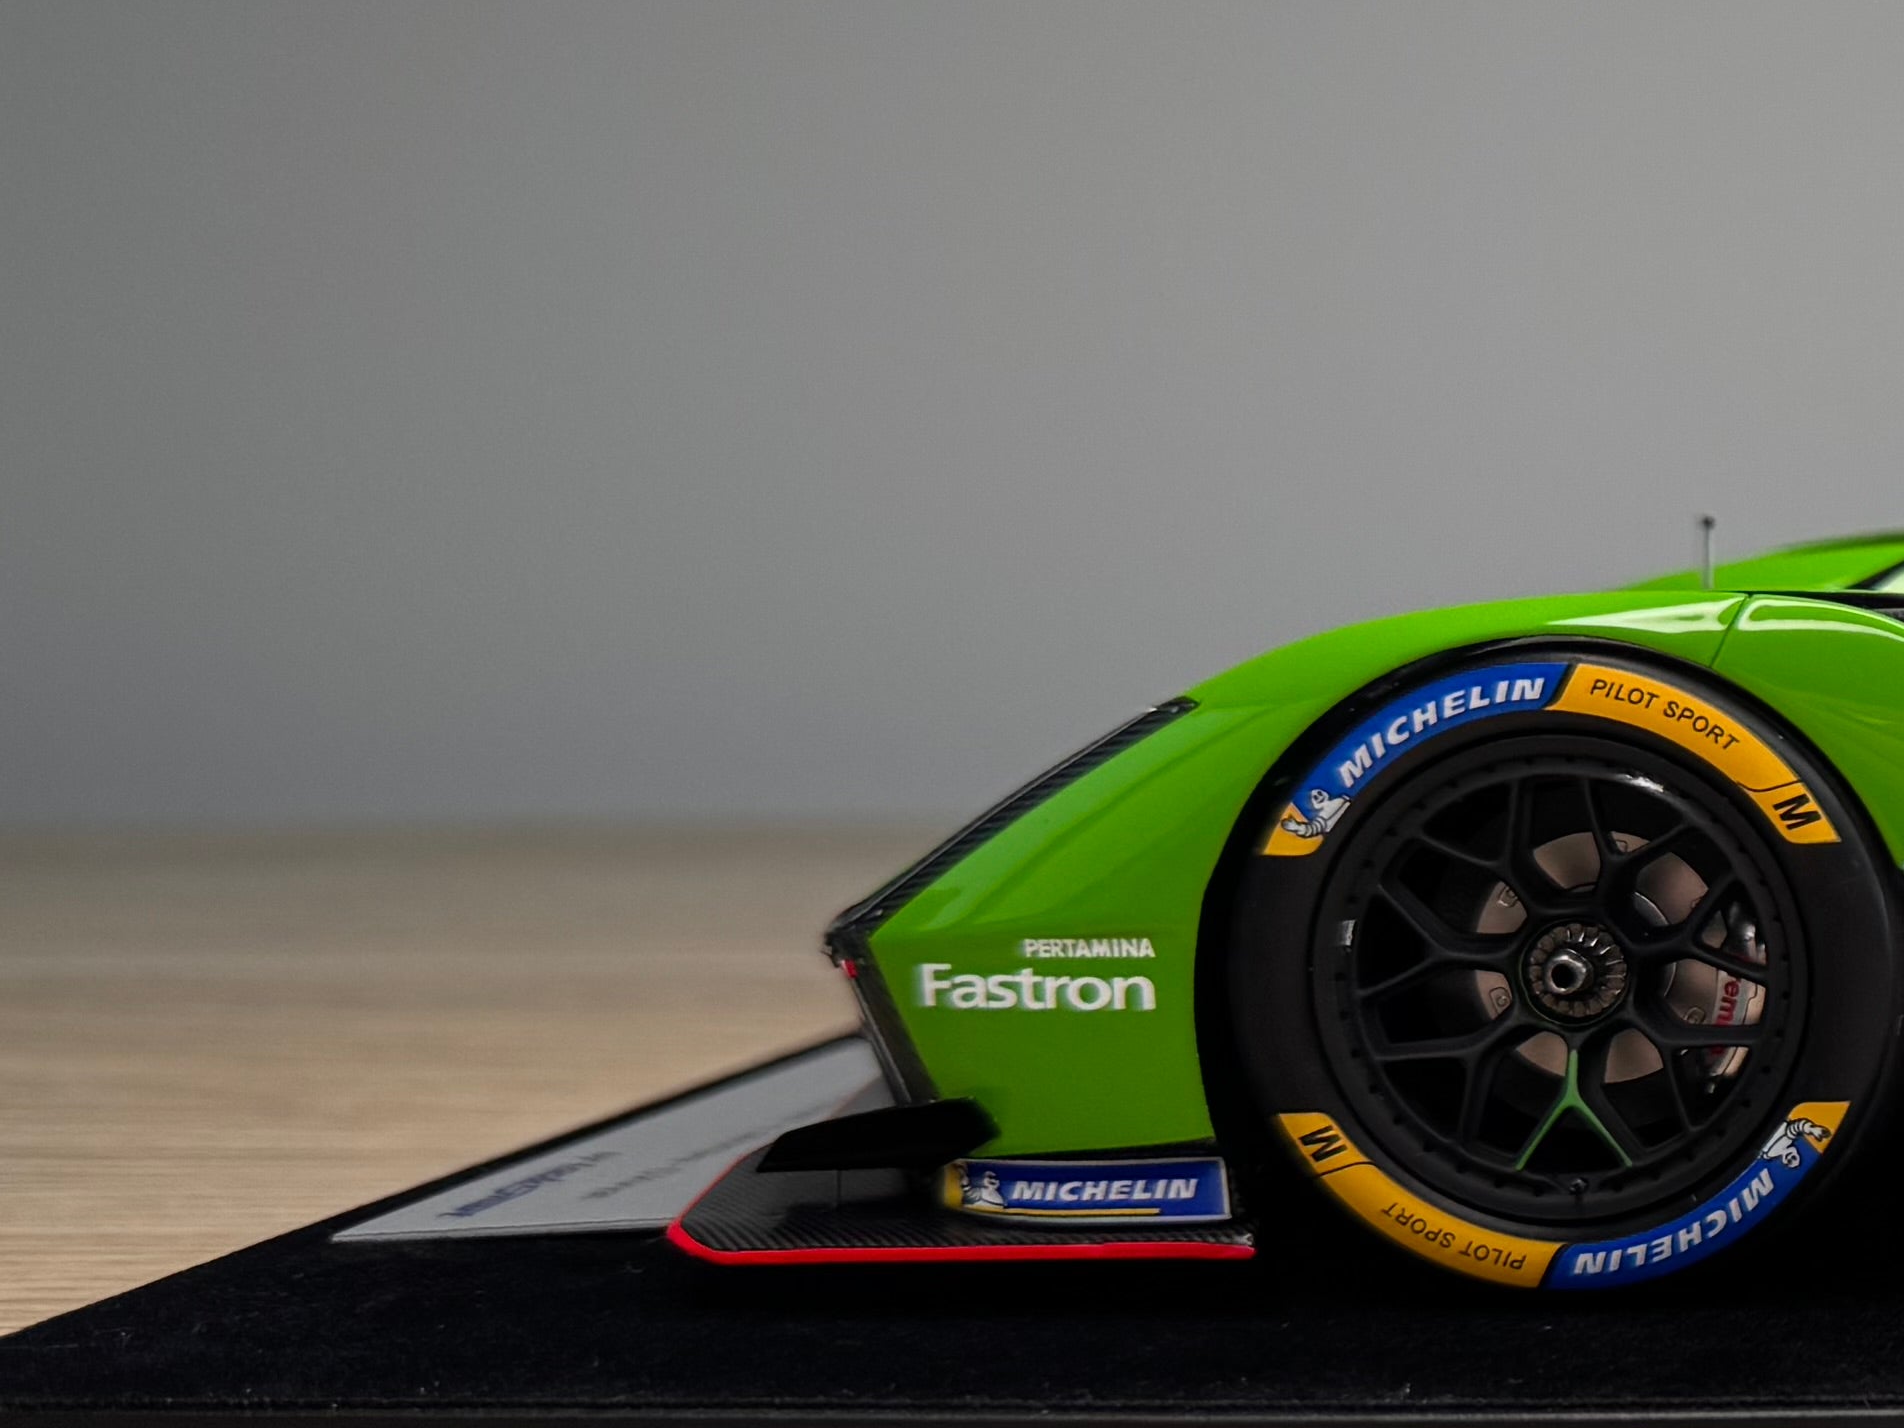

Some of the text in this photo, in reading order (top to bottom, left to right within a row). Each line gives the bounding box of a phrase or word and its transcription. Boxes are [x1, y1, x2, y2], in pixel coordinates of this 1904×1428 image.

[1338, 677, 1546, 788] MICHELIN
[1590, 678, 1740, 750] PILOT SPORT
[1772, 793, 1822, 831] M
[1023, 939, 1156, 958] PERTAMINA
[919, 963, 1157, 1011] Fastron
[1011, 1177, 1198, 1202] MICHELIN
[1380, 1202, 1527, 1271] PILOT SPORT
[1572, 1167, 1775, 1275] MICHELIN
